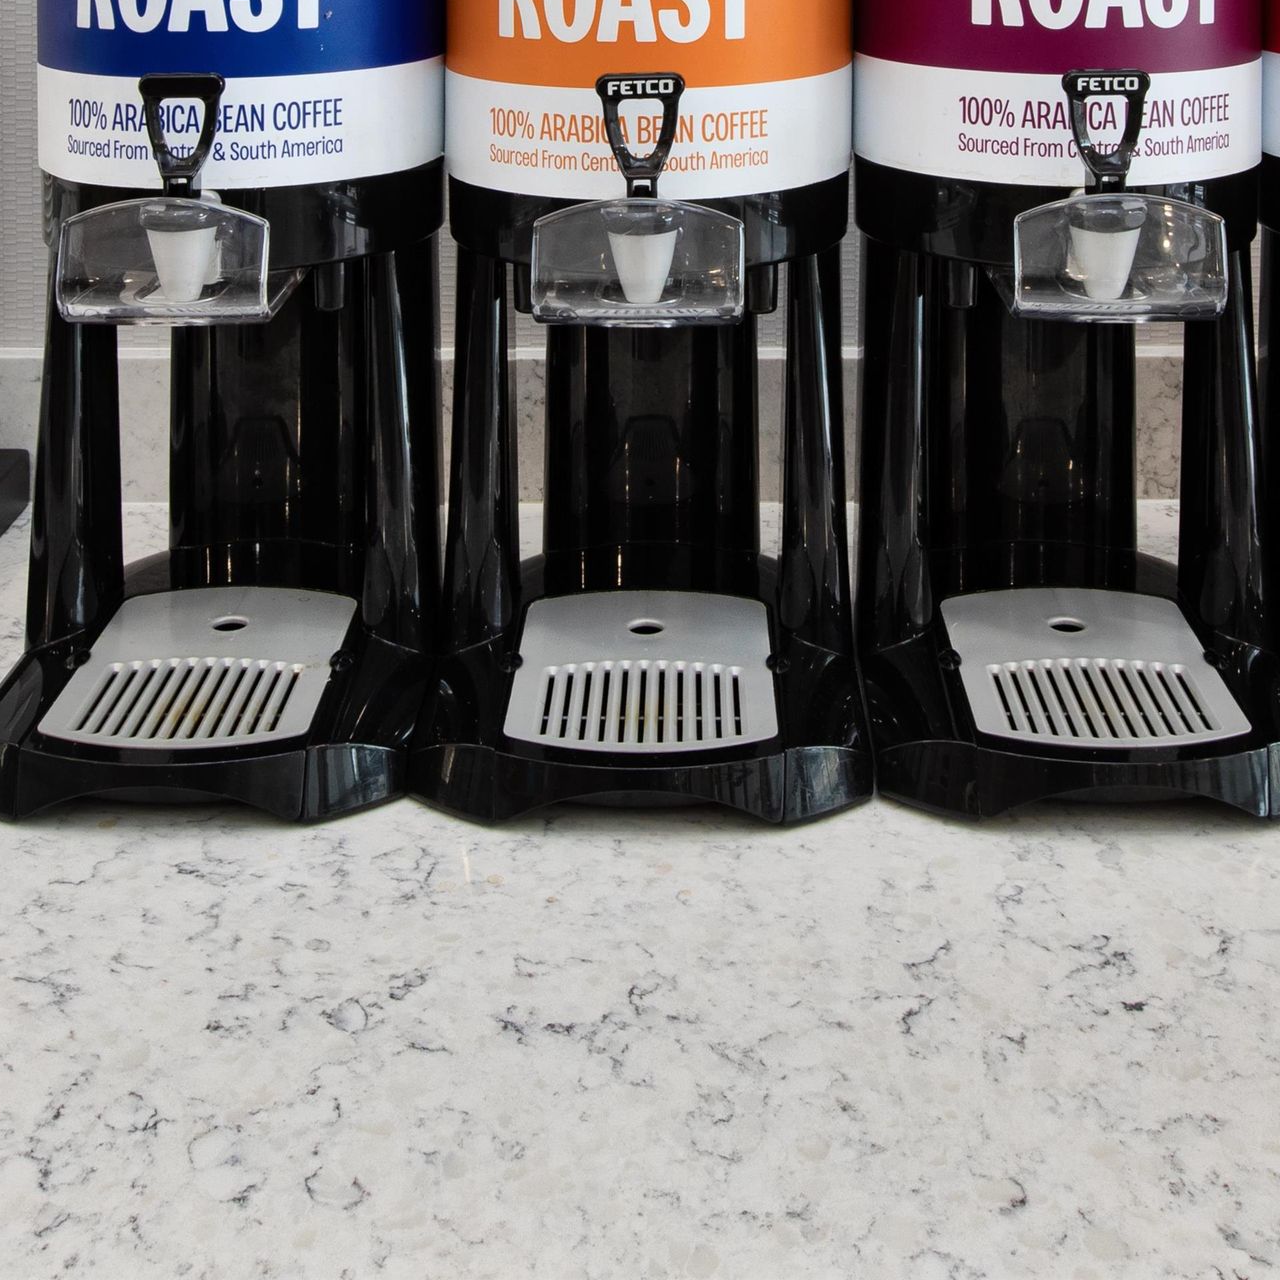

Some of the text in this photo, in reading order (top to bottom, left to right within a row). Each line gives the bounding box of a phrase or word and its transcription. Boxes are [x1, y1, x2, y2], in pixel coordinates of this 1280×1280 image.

[607, 80, 675, 96] FETCO
[1077, 77, 1139, 91] FETCO
[68, 98, 107, 130] 100%
[273, 98, 343, 131] COFFEE
[490, 107, 535, 139] 100%
[637, 116, 694, 144] BEN
[701, 109, 768, 143] COFFEE
[959, 93, 1230, 131] 100% ARAICA EAN COFFEE
[68, 134, 110, 158] Sourced
[114, 140, 148, 160] From
[212, 142, 226, 160] &
[230, 139, 276, 160] South
[281, 136, 343, 158] America
[490, 144, 538, 167] Sourced
[542, 149, 577, 170] From
[710, 147, 768, 169] America
[958, 132, 1019, 156] Sourced
[1023, 137, 1063, 158] From
[1068, 139, 1119, 158] Ctra
[1144, 136, 1184, 157] South
[1186, 130, 1230, 154] America
